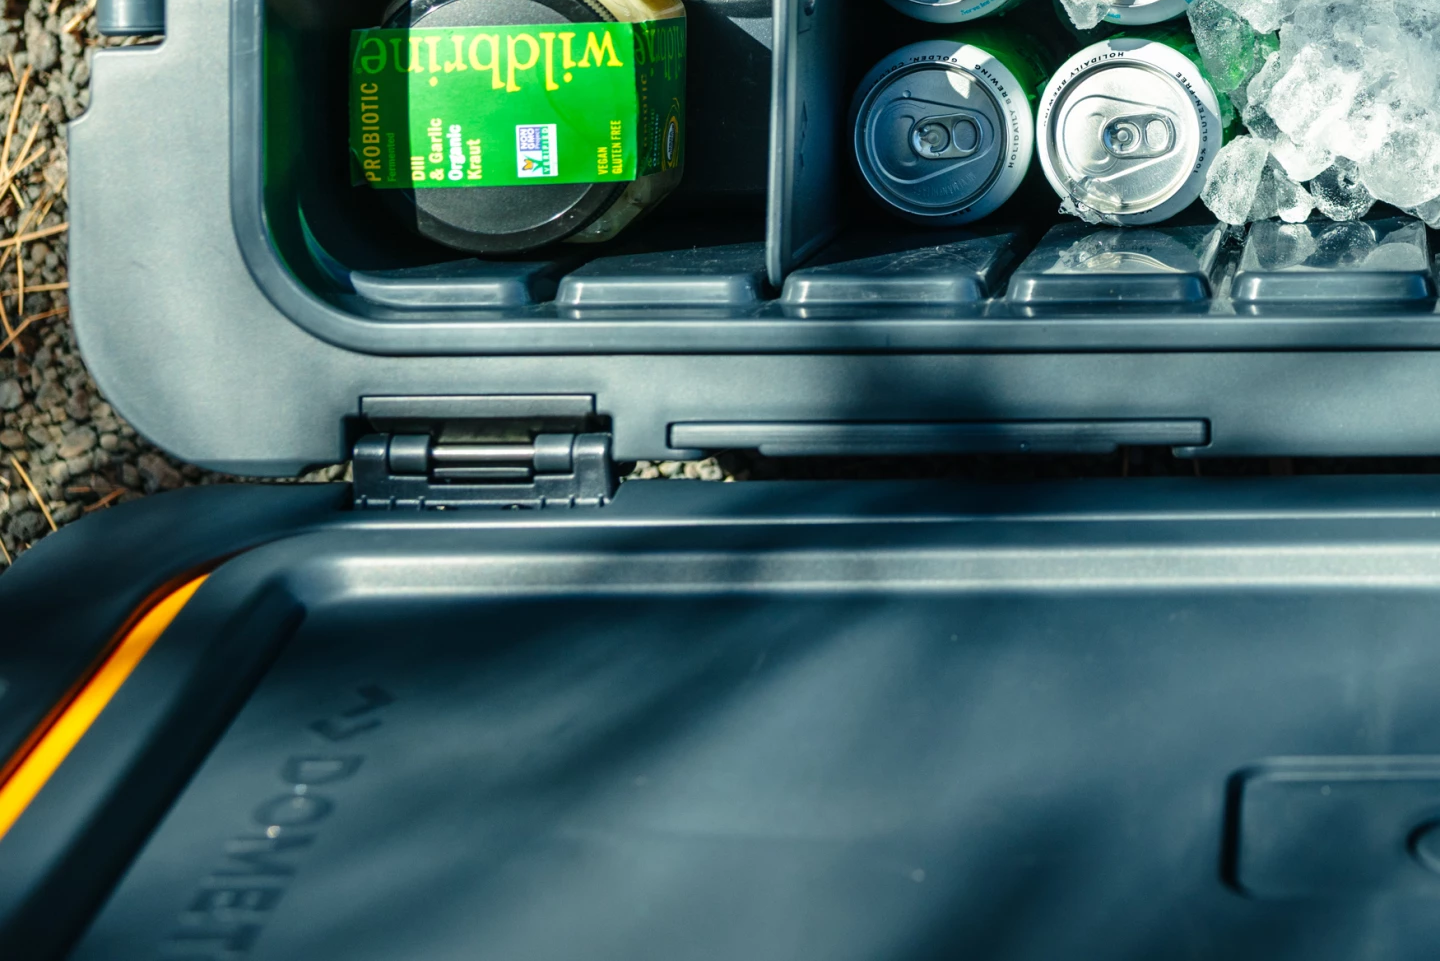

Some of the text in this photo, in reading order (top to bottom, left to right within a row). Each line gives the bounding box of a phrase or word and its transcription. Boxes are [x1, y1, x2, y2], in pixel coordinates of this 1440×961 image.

[360, 30, 624, 93] wildbrine
[974, 64, 1008, 104] BREWING
[1070, 51, 1124, 78] HOLIDAILY
[360, 82, 382, 182] PROBIOTIC
[386, 132, 397, 182] Fermented
[427, 118, 445, 181] & Garlic
[446, 124, 466, 181] Organic
[610, 120, 623, 174] GLUTEN FREE
[410, 155, 426, 181] Dill
[466, 138, 483, 180] Kraut
[597, 146, 608, 175] VEGAN
[164, 753, 366, 961] DOMET
